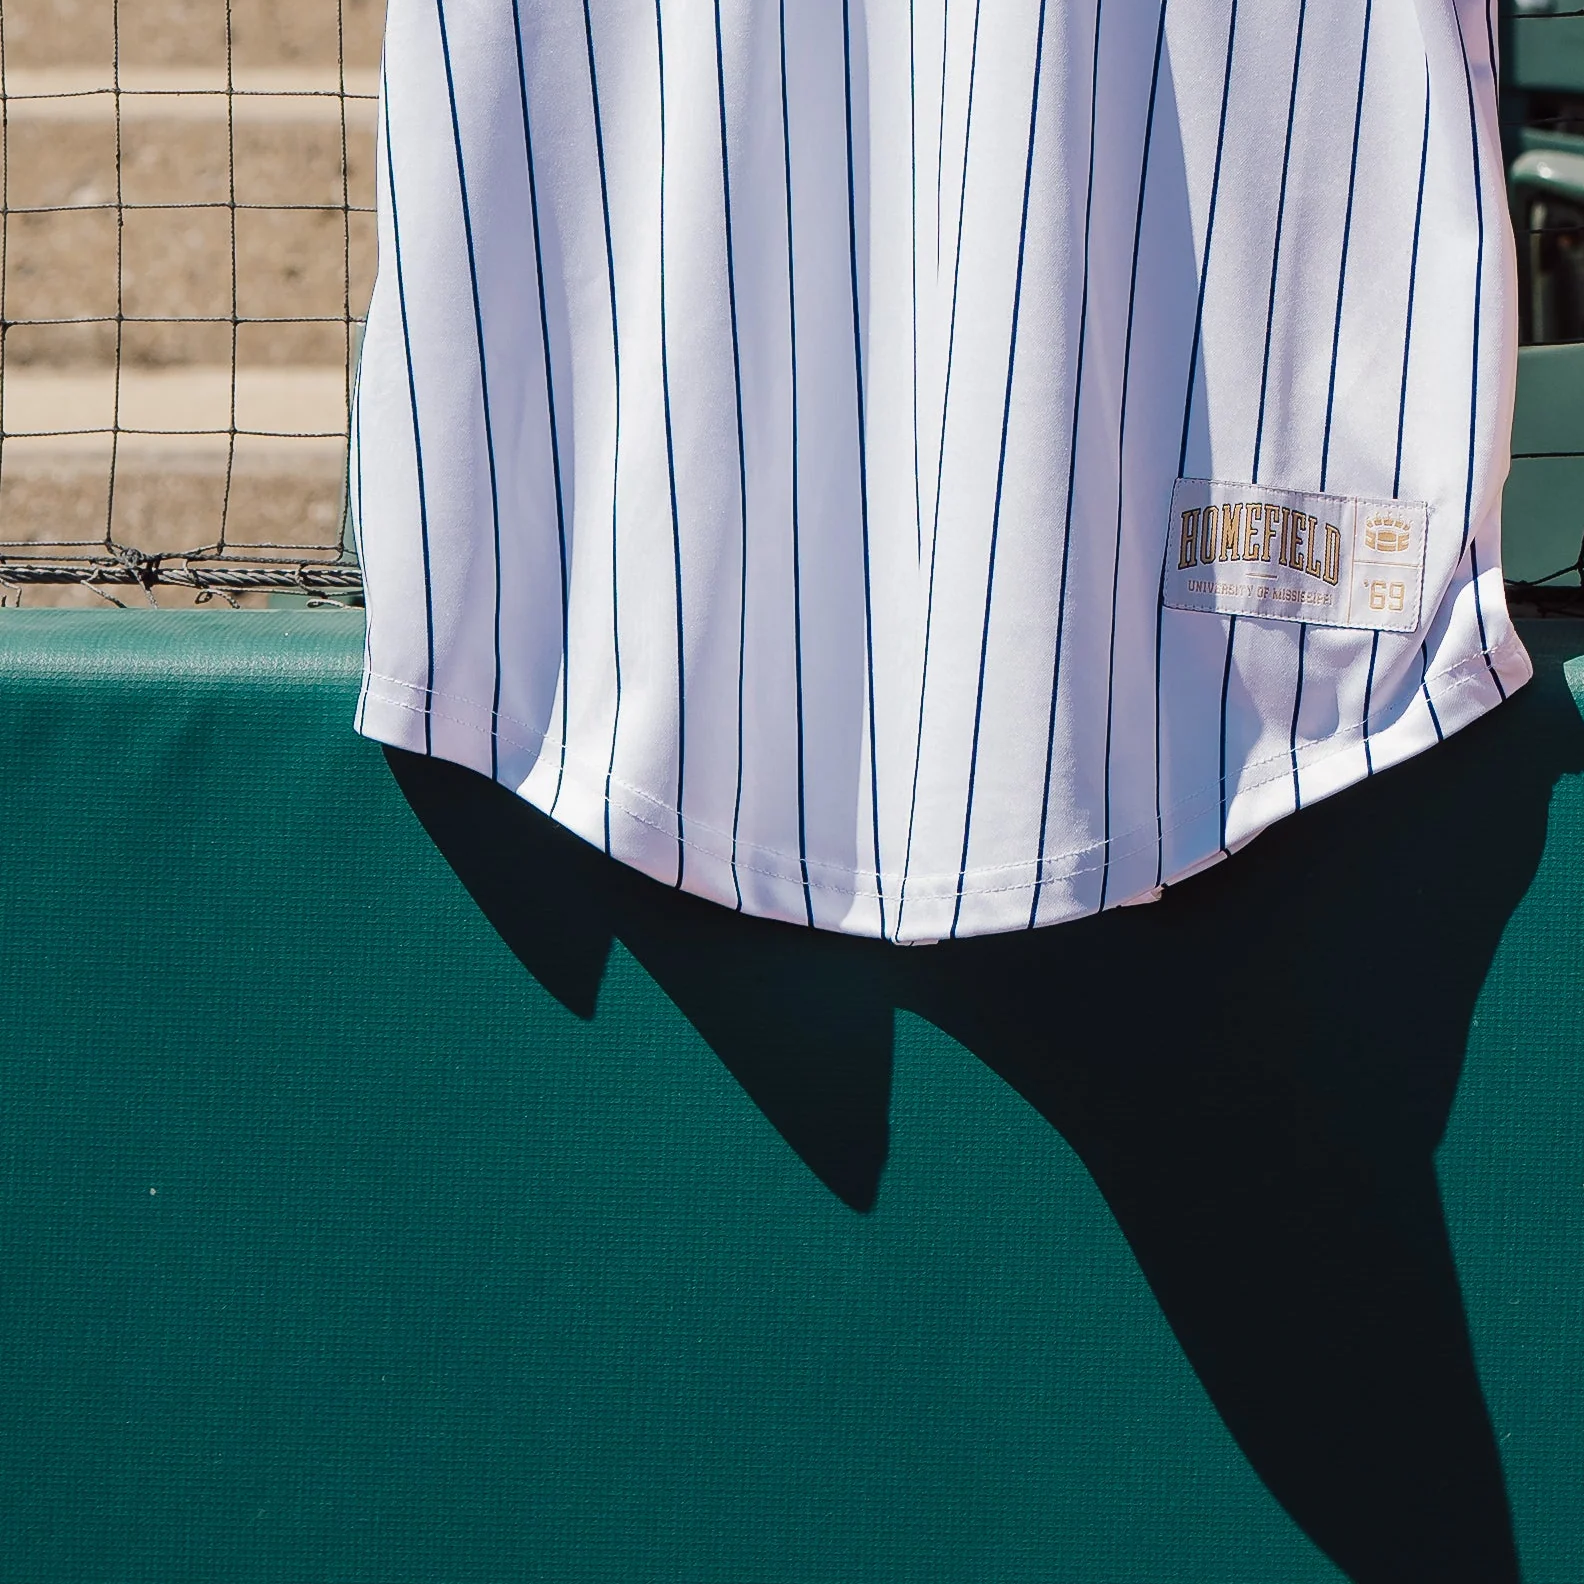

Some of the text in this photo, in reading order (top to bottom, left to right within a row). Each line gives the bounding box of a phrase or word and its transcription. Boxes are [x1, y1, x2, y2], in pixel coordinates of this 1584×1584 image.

[1177, 502, 1341, 587] HOMEFIELD
[1188, 580, 1334, 606] UNIVERSITY OF MISSISSIPPI
[1363, 579, 1405, 612] '69
